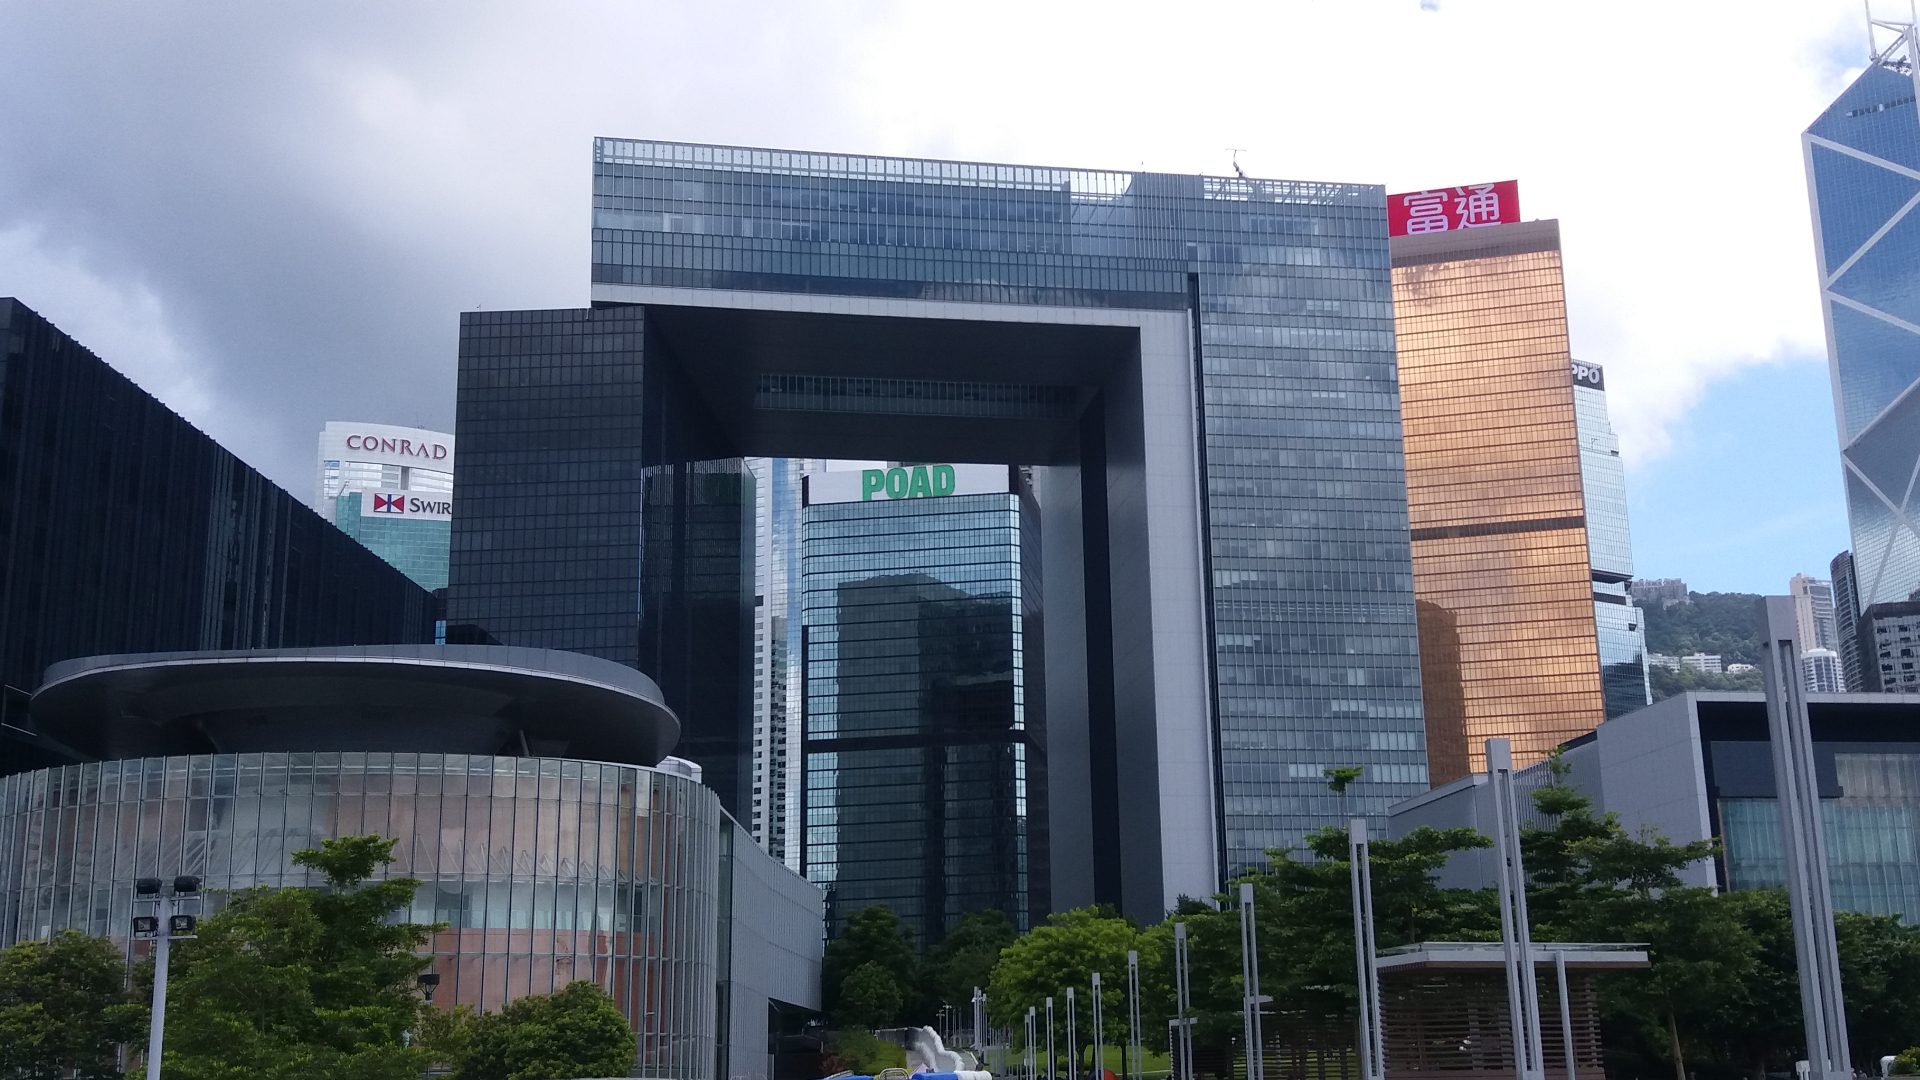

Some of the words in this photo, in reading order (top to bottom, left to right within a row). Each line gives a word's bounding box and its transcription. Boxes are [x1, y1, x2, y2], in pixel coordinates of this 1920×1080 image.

[1404, 184, 1502, 235] 富通
[347, 435, 447, 460] CONRAD
[862, 464, 956, 501] POAD
